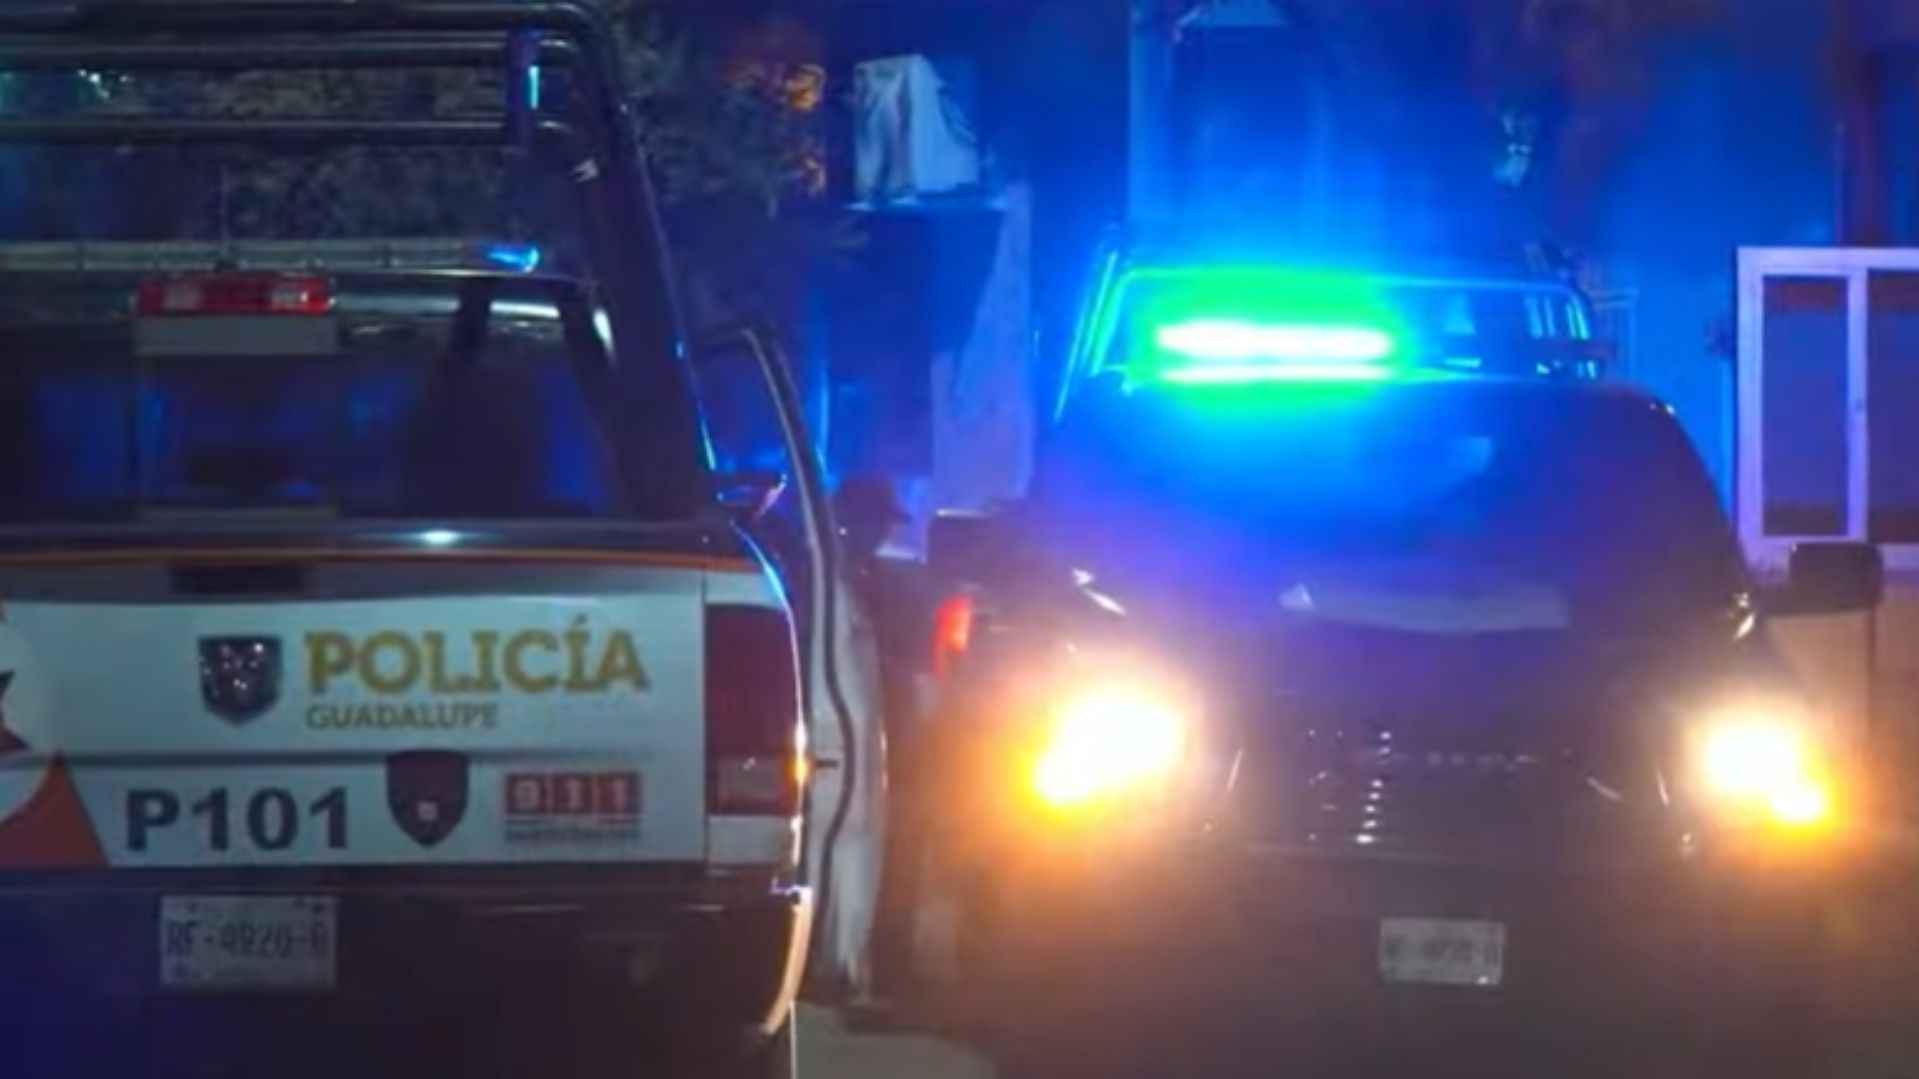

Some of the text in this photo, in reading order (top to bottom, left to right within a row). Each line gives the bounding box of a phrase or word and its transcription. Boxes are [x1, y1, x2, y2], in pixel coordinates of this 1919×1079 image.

[304, 614, 650, 695] POLICÍA
[305, 704, 499, 730] GUADALUPE
[126, 786, 348, 851] P101
[511, 777, 630, 812] 911
